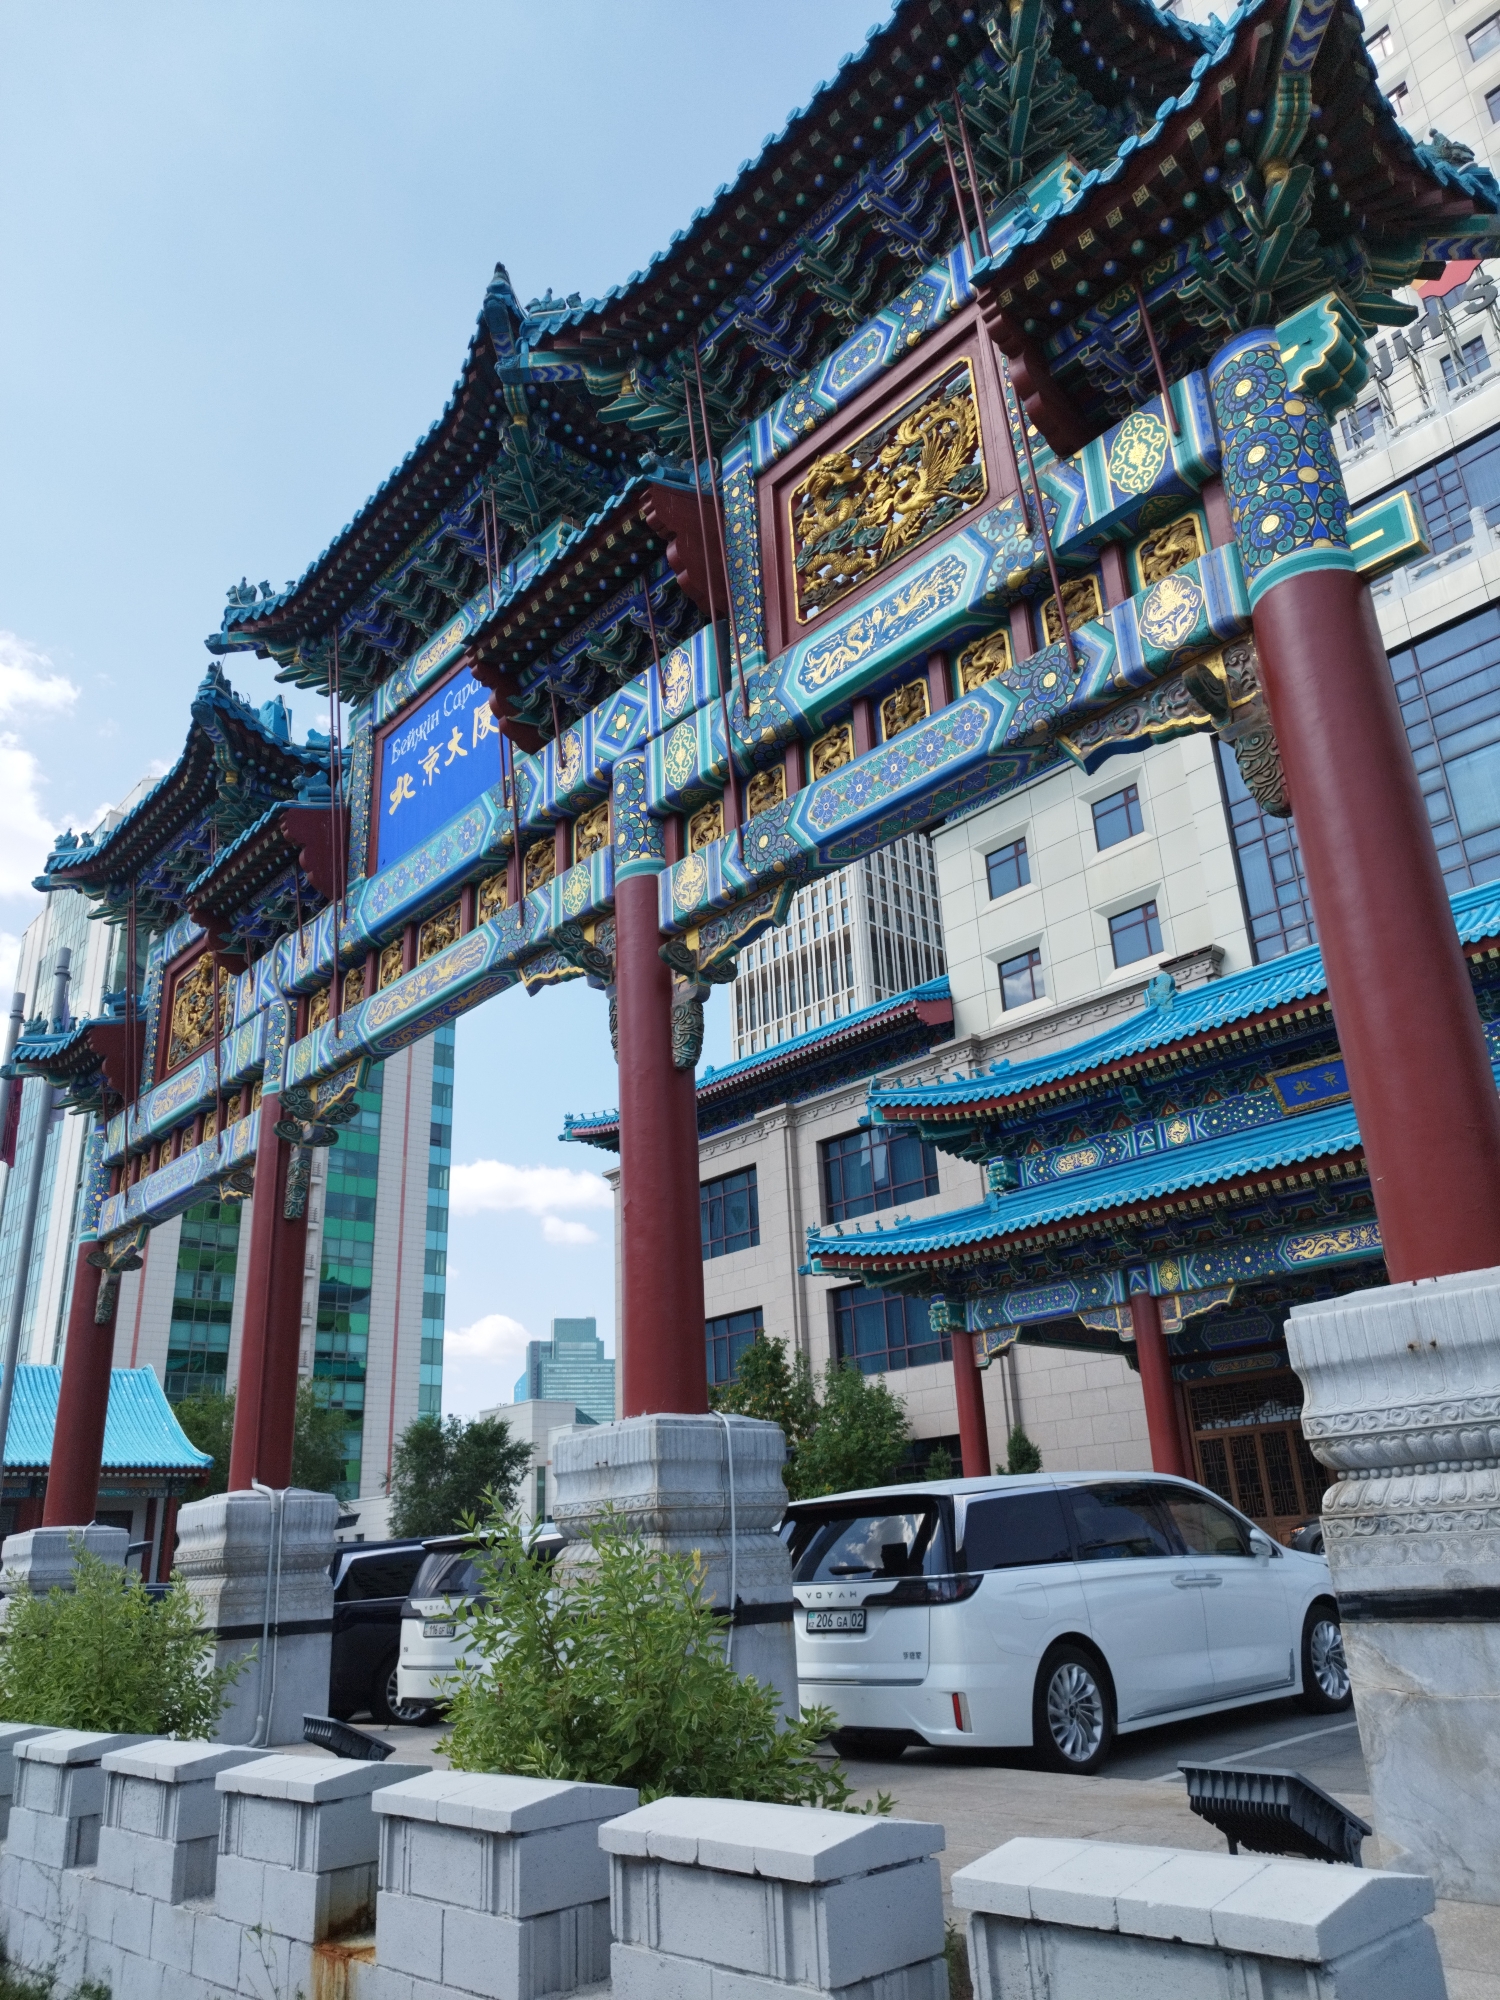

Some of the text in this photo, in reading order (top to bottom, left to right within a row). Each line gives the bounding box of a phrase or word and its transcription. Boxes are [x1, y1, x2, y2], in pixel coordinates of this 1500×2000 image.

[444, 678, 483, 717] Сара
[388, 700, 499, 816] 北京大厦
[806, 1591, 857, 1599] VOYAH
[816, 1613, 833, 1628] 206
[836, 1616, 849, 1628] GA
[851, 1612, 864, 1628] 02
